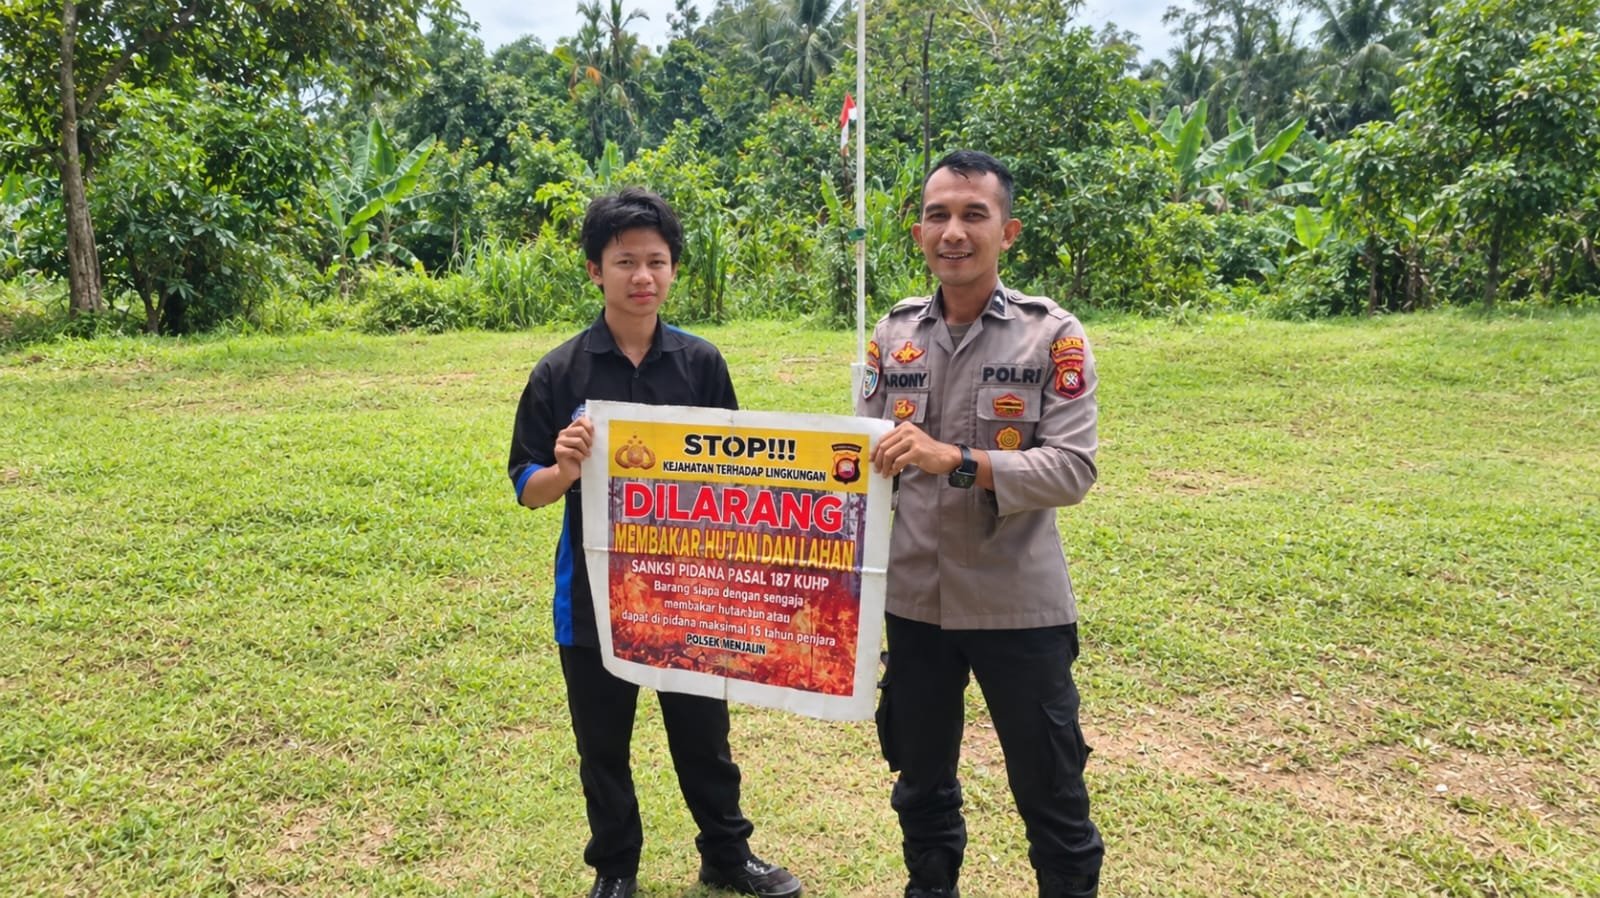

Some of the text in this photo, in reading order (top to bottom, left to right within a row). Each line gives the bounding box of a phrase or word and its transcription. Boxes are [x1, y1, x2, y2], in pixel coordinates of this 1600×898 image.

[982, 366, 1042, 383] POLRI
[684, 433, 797, 461] STOP!!!
[663, 460, 826, 482] KEJAHATAN TERHADAP LINGKUNGAN
[623, 482, 844, 534] DILARANG
[614, 523, 855, 572] MEMBAKAR HUTAN DAN LAHAN
[632, 559, 829, 591] SANKSI PIDANA PASAL 187 KUHP
[654, 580, 804, 608] Barang siapa dengan sengaja
[664, 599, 715, 613] membakar
[766, 611, 790, 624] atau
[622, 609, 836, 647] dapat di pidana maksimal 15 tahun penjara
[686, 633, 766, 655] POLSEK MENJALIN
